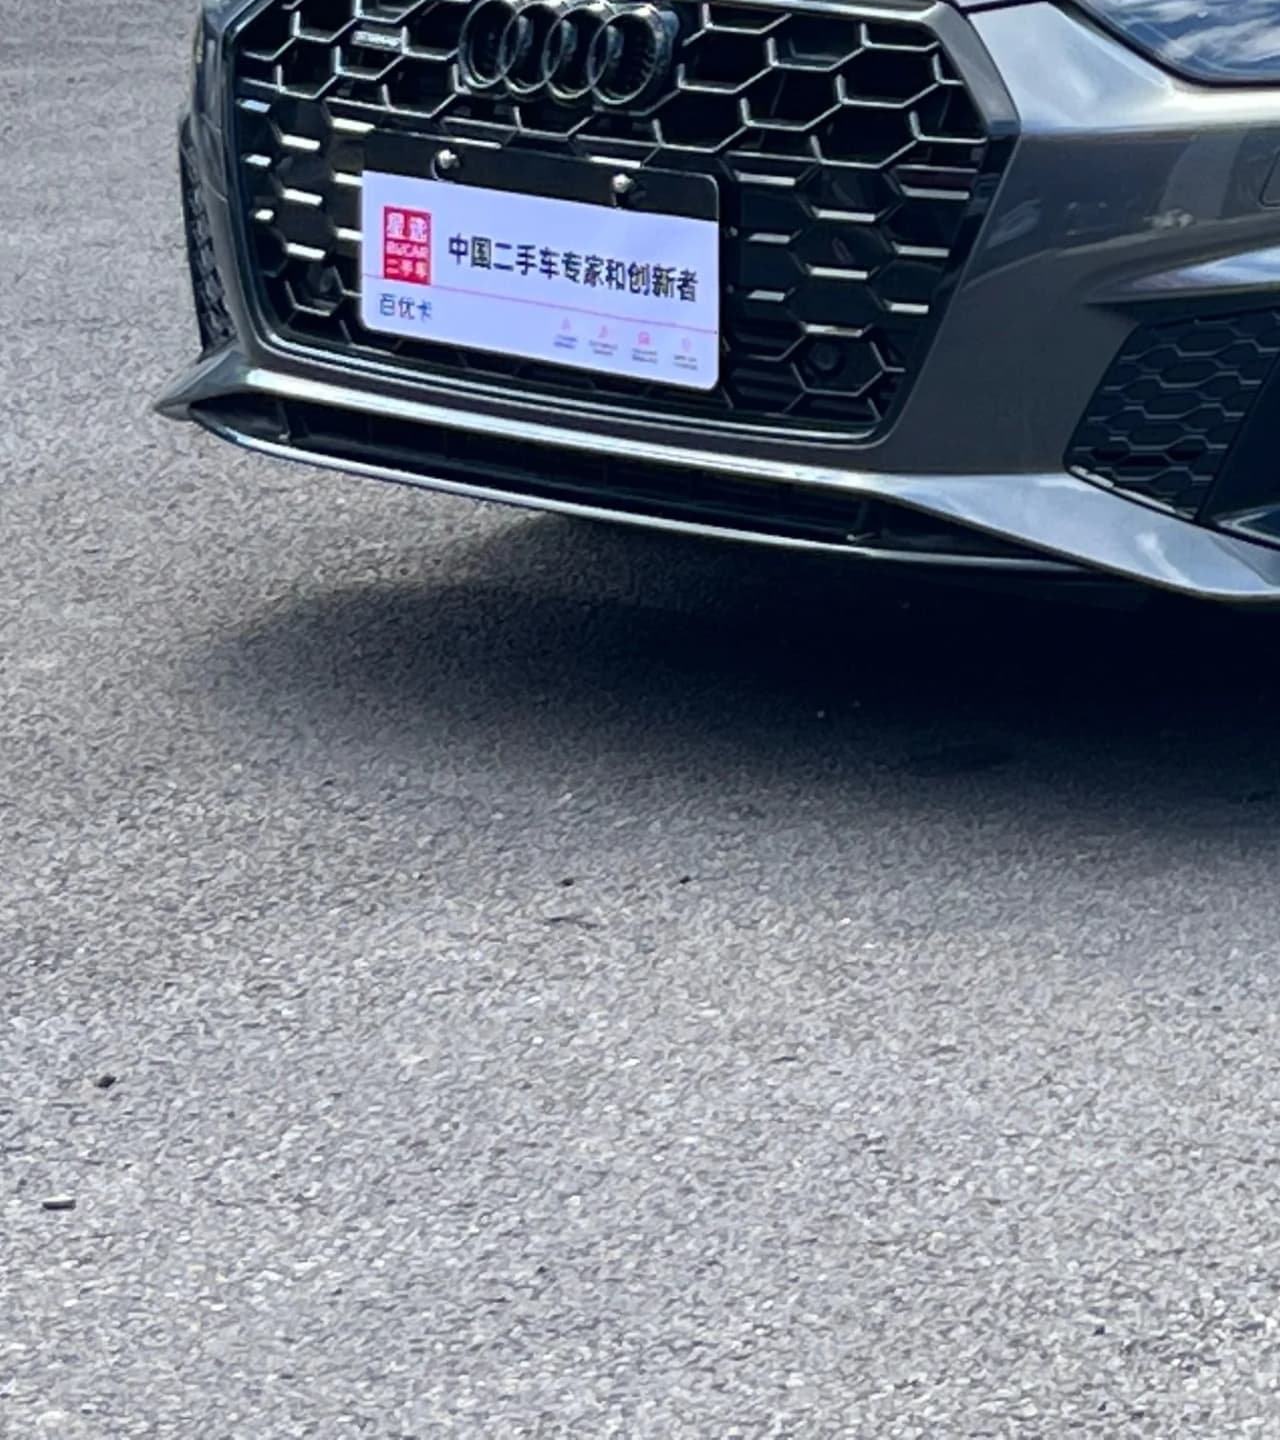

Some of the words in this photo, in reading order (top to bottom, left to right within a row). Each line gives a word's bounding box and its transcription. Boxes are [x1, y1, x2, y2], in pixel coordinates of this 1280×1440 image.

[448, 233, 699, 302] 中国二手车专家和创新者
[379, 292, 432, 322] 百优卡
